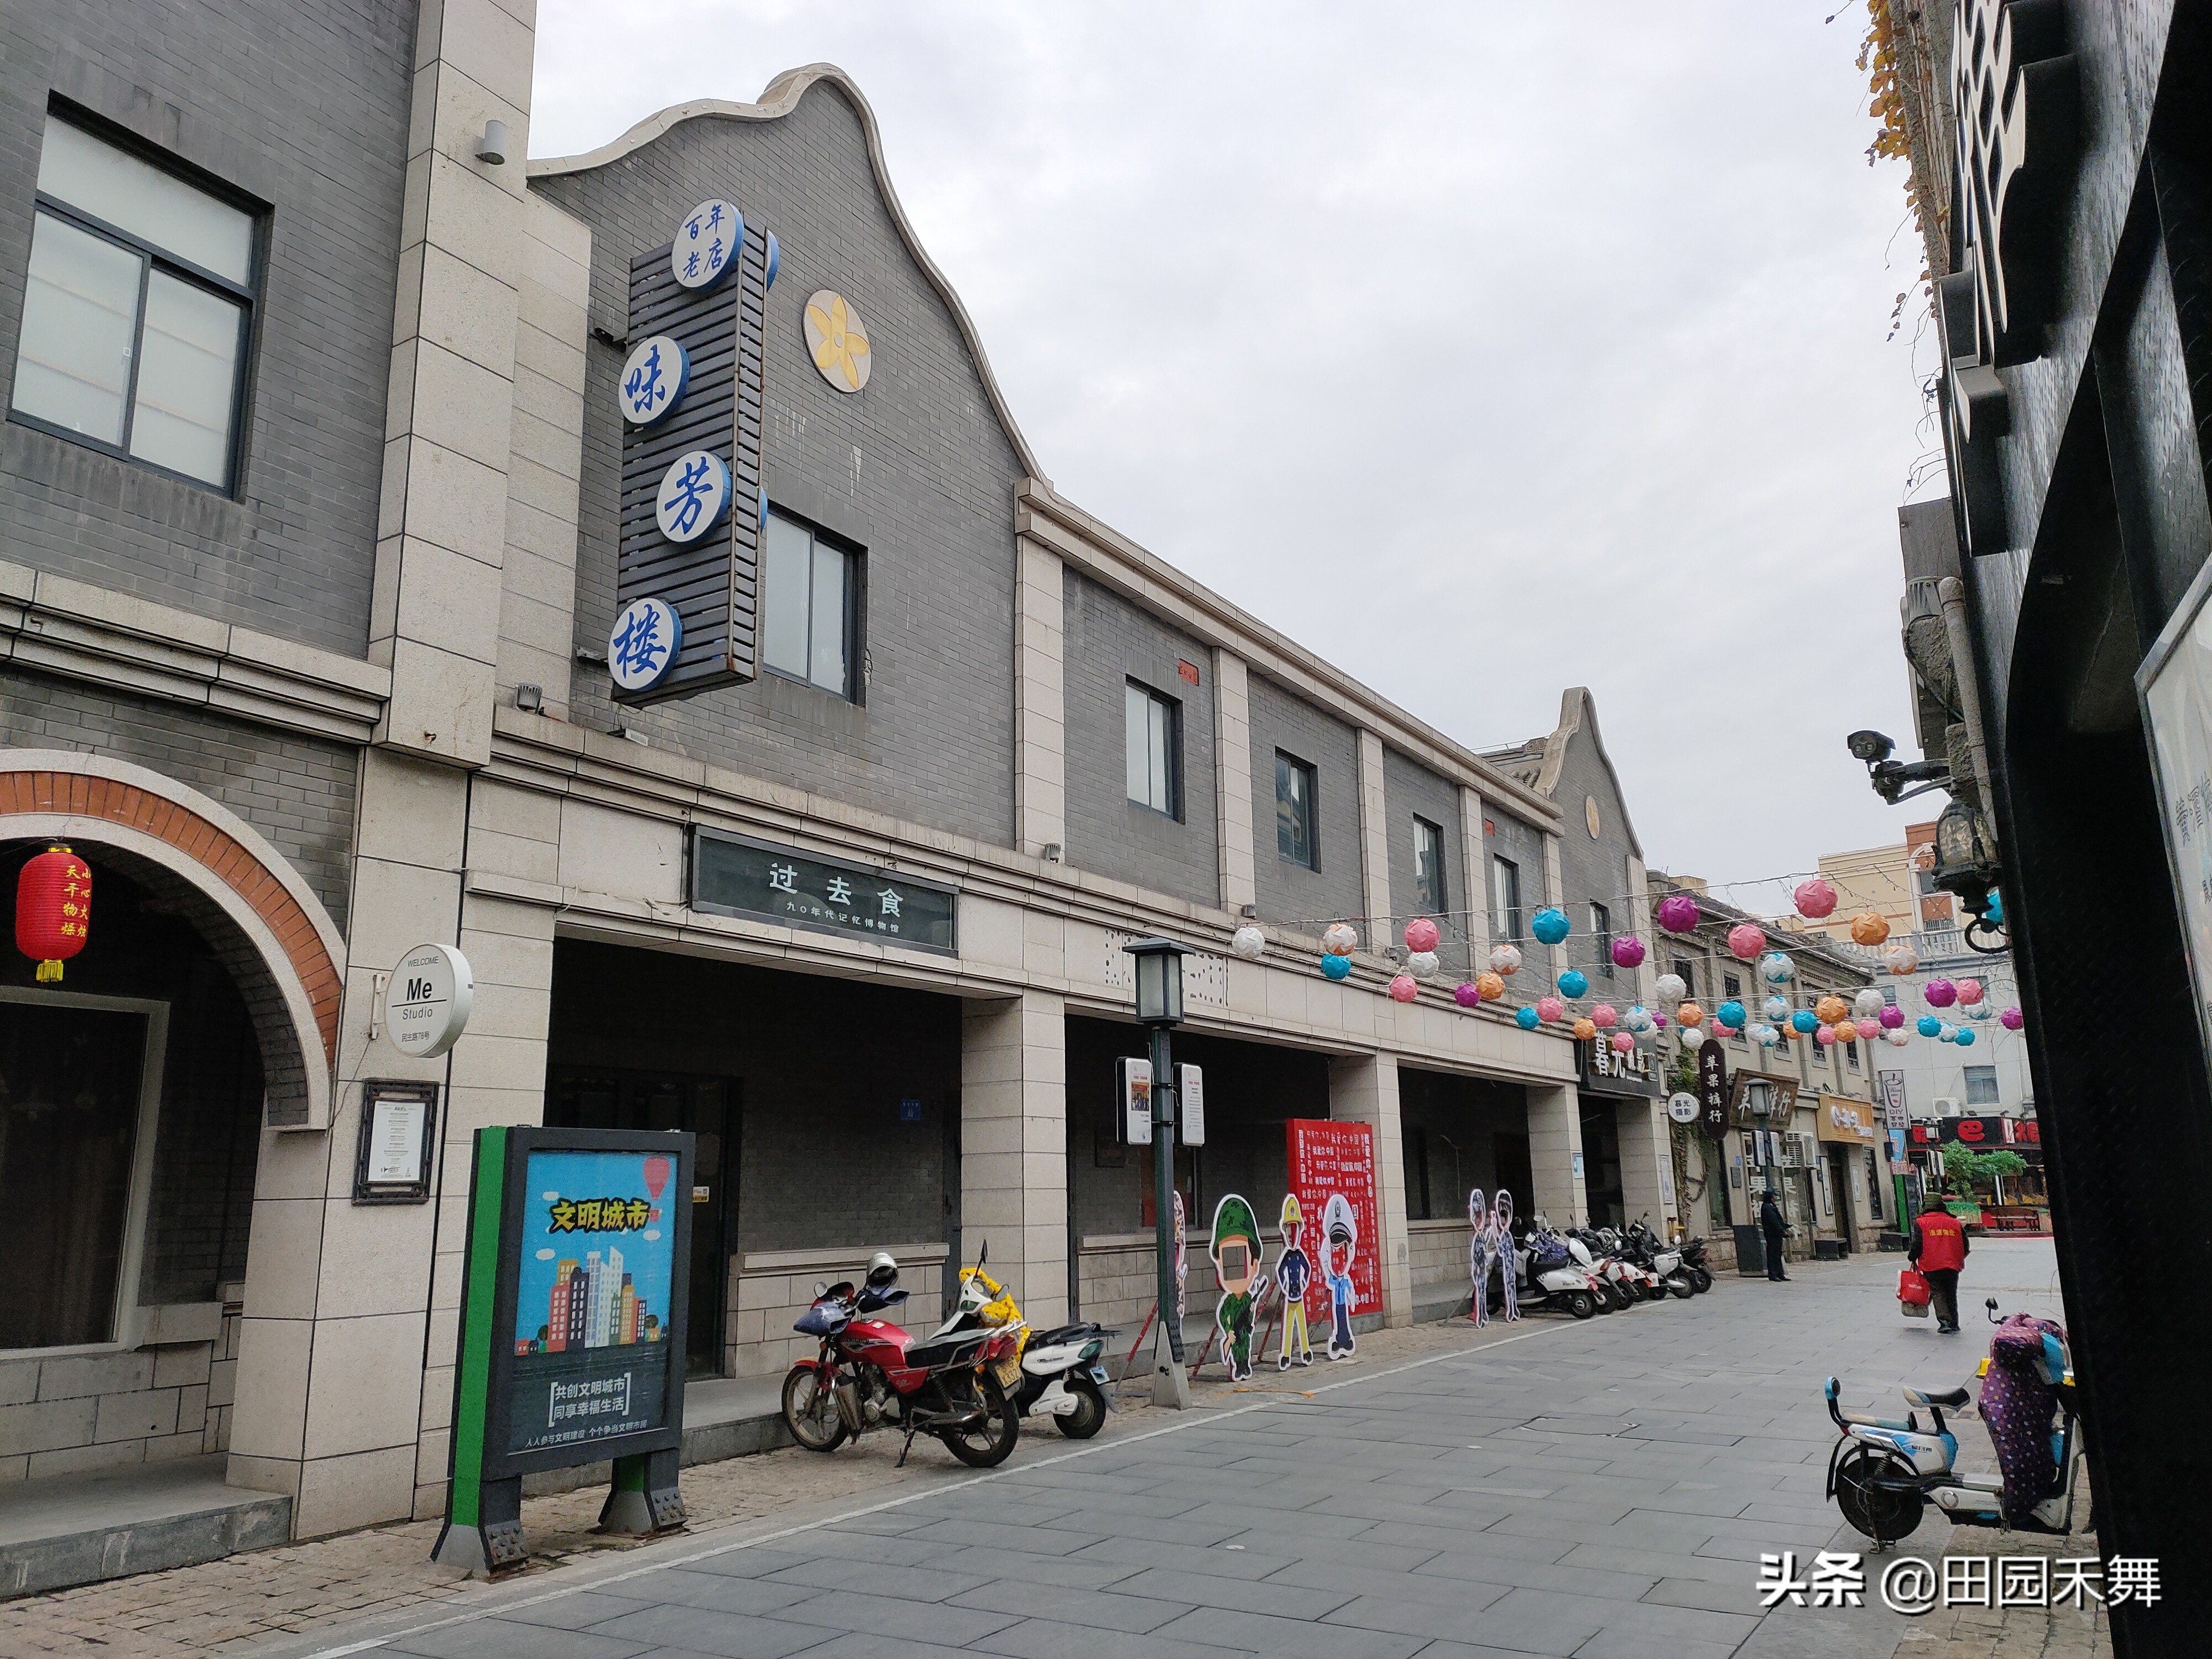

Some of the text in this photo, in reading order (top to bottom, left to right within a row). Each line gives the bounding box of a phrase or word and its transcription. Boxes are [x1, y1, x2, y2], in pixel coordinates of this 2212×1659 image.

[685, 204, 726, 240] 百年
[683, 238, 723, 281] 老店
[613, 345, 713, 680] 味芳楼
[60, 865, 82, 935] 天干物燥
[769, 862, 904, 918] 过去食
[408, 956, 439, 968] WELCOME
[406, 977, 432, 1001] Me
[402, 1007, 433, 1020] Studio
[552, 1200, 649, 1232] 文明城市
[555, 1378, 625, 1401] 共创文明城市
[553, 1396, 624, 1421] 同享幸福生活
